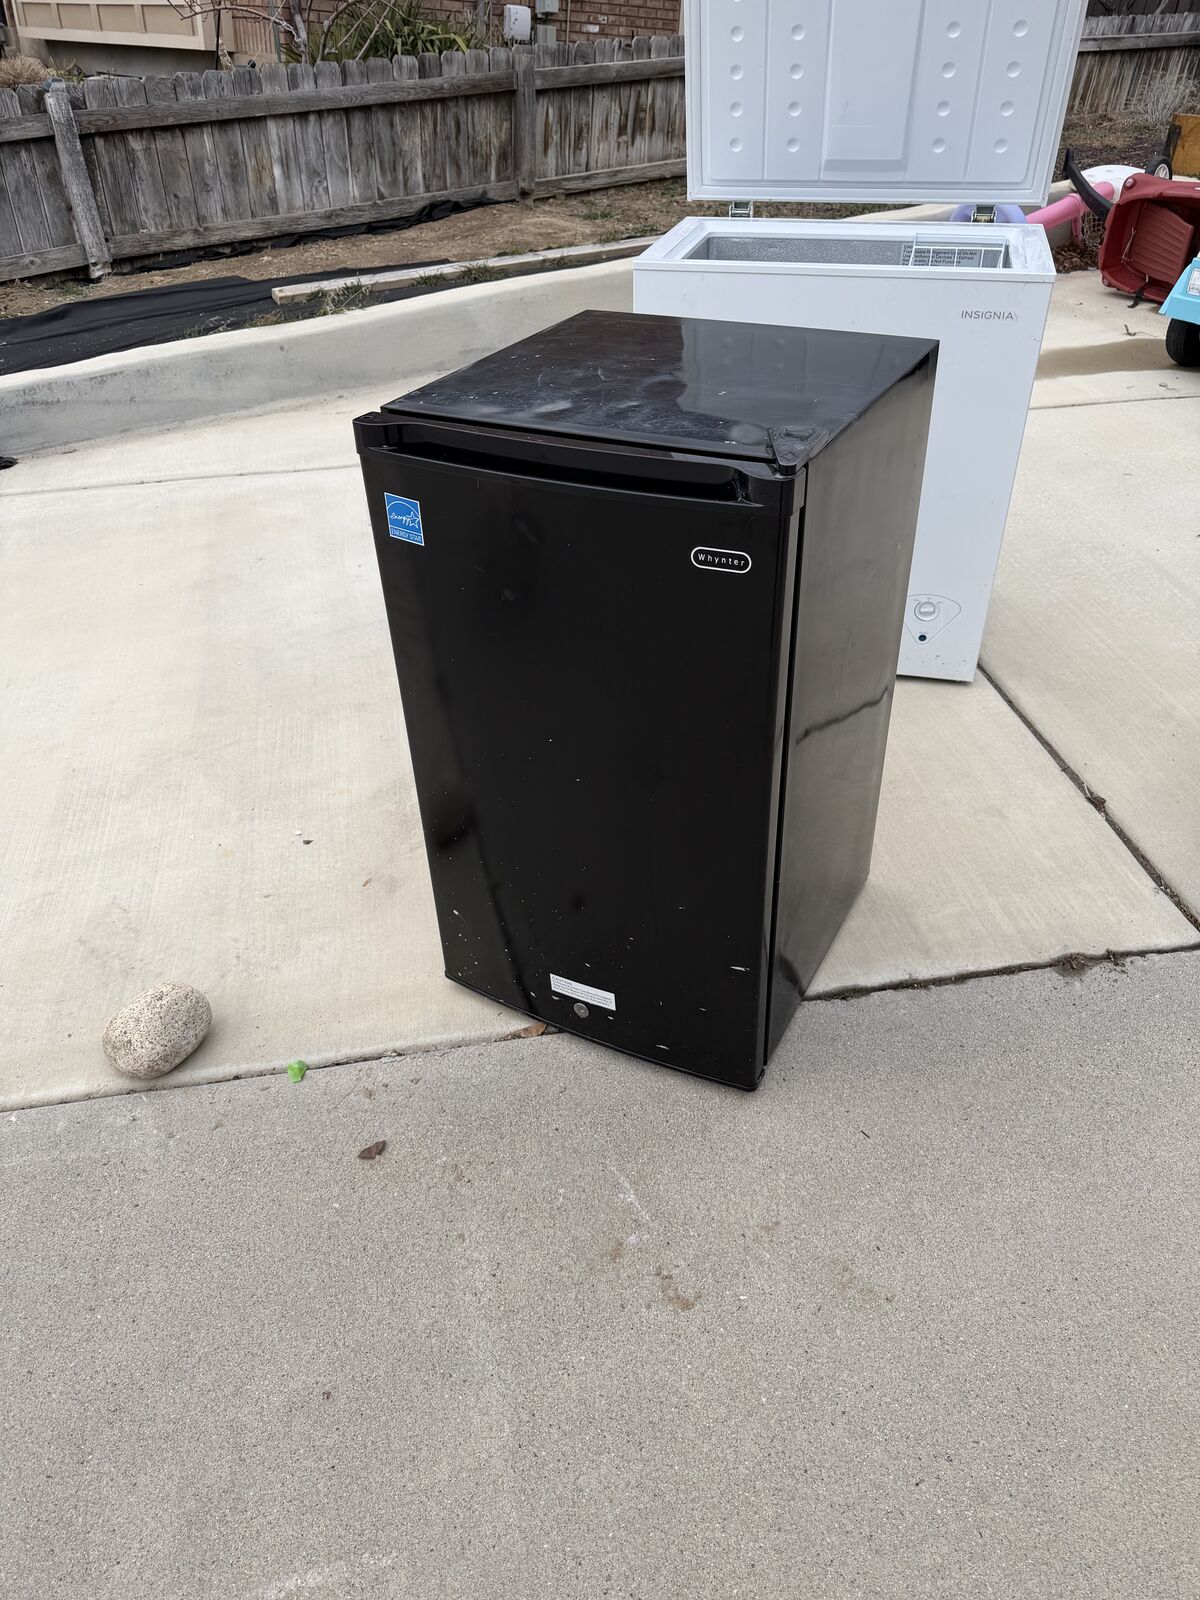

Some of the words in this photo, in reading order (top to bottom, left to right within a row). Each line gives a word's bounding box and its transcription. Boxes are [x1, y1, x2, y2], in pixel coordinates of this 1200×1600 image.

[961, 310, 1013, 320] INSIGNIA
[391, 528, 409, 538] ENERGY
[410, 533, 422, 542] STAR
[698, 553, 745, 566] Whynter
